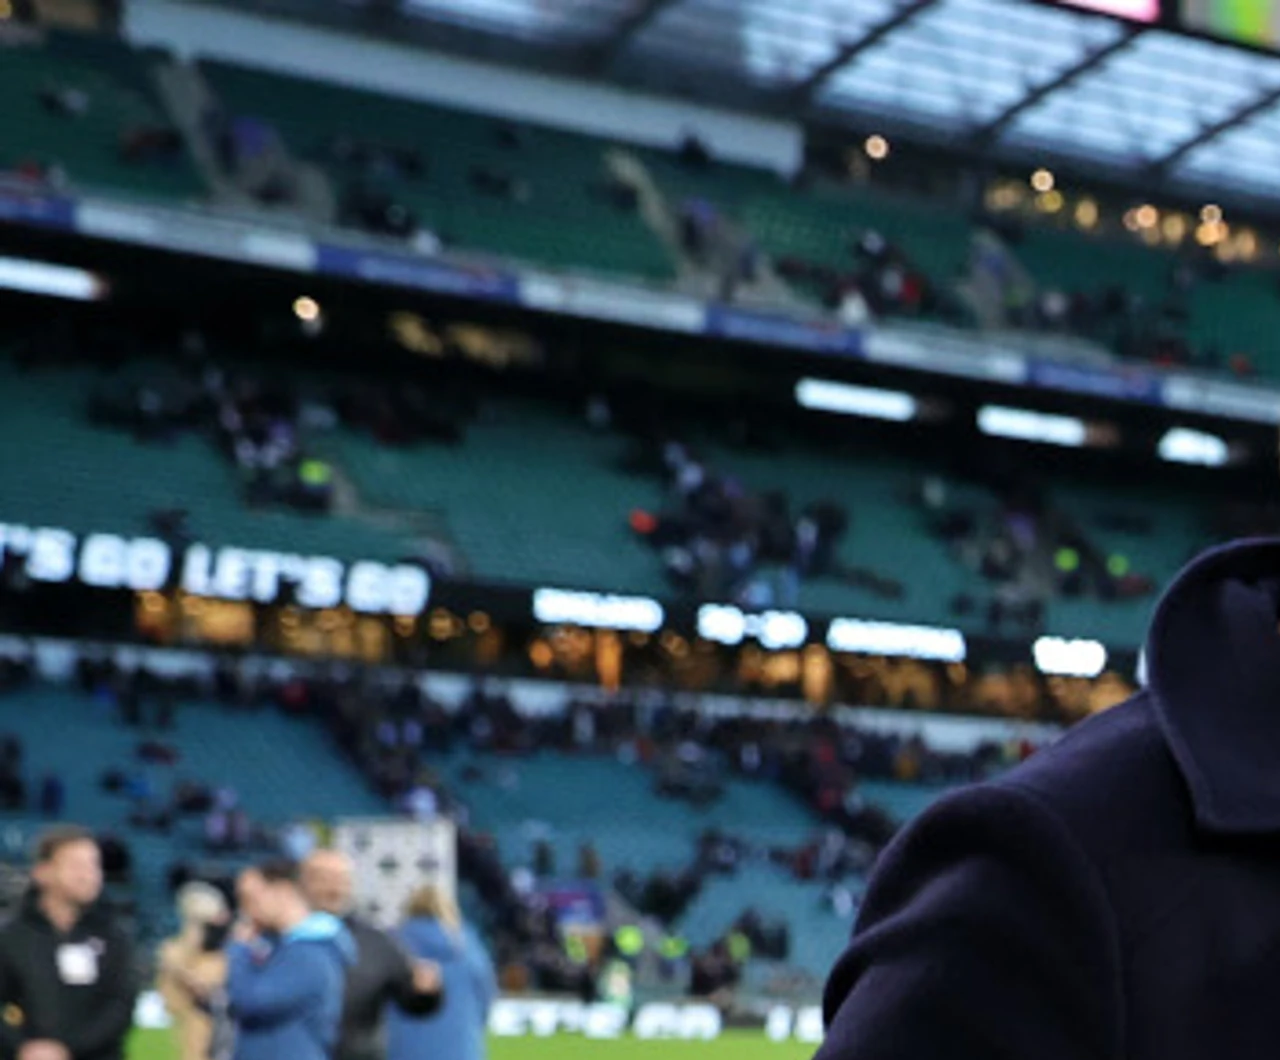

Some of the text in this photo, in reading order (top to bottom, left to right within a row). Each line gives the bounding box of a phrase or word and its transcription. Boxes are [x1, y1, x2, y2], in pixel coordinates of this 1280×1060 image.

[81, 533, 169, 590] GO
[184, 543, 343, 607] LET'S
[346, 561, 429, 615] GO
